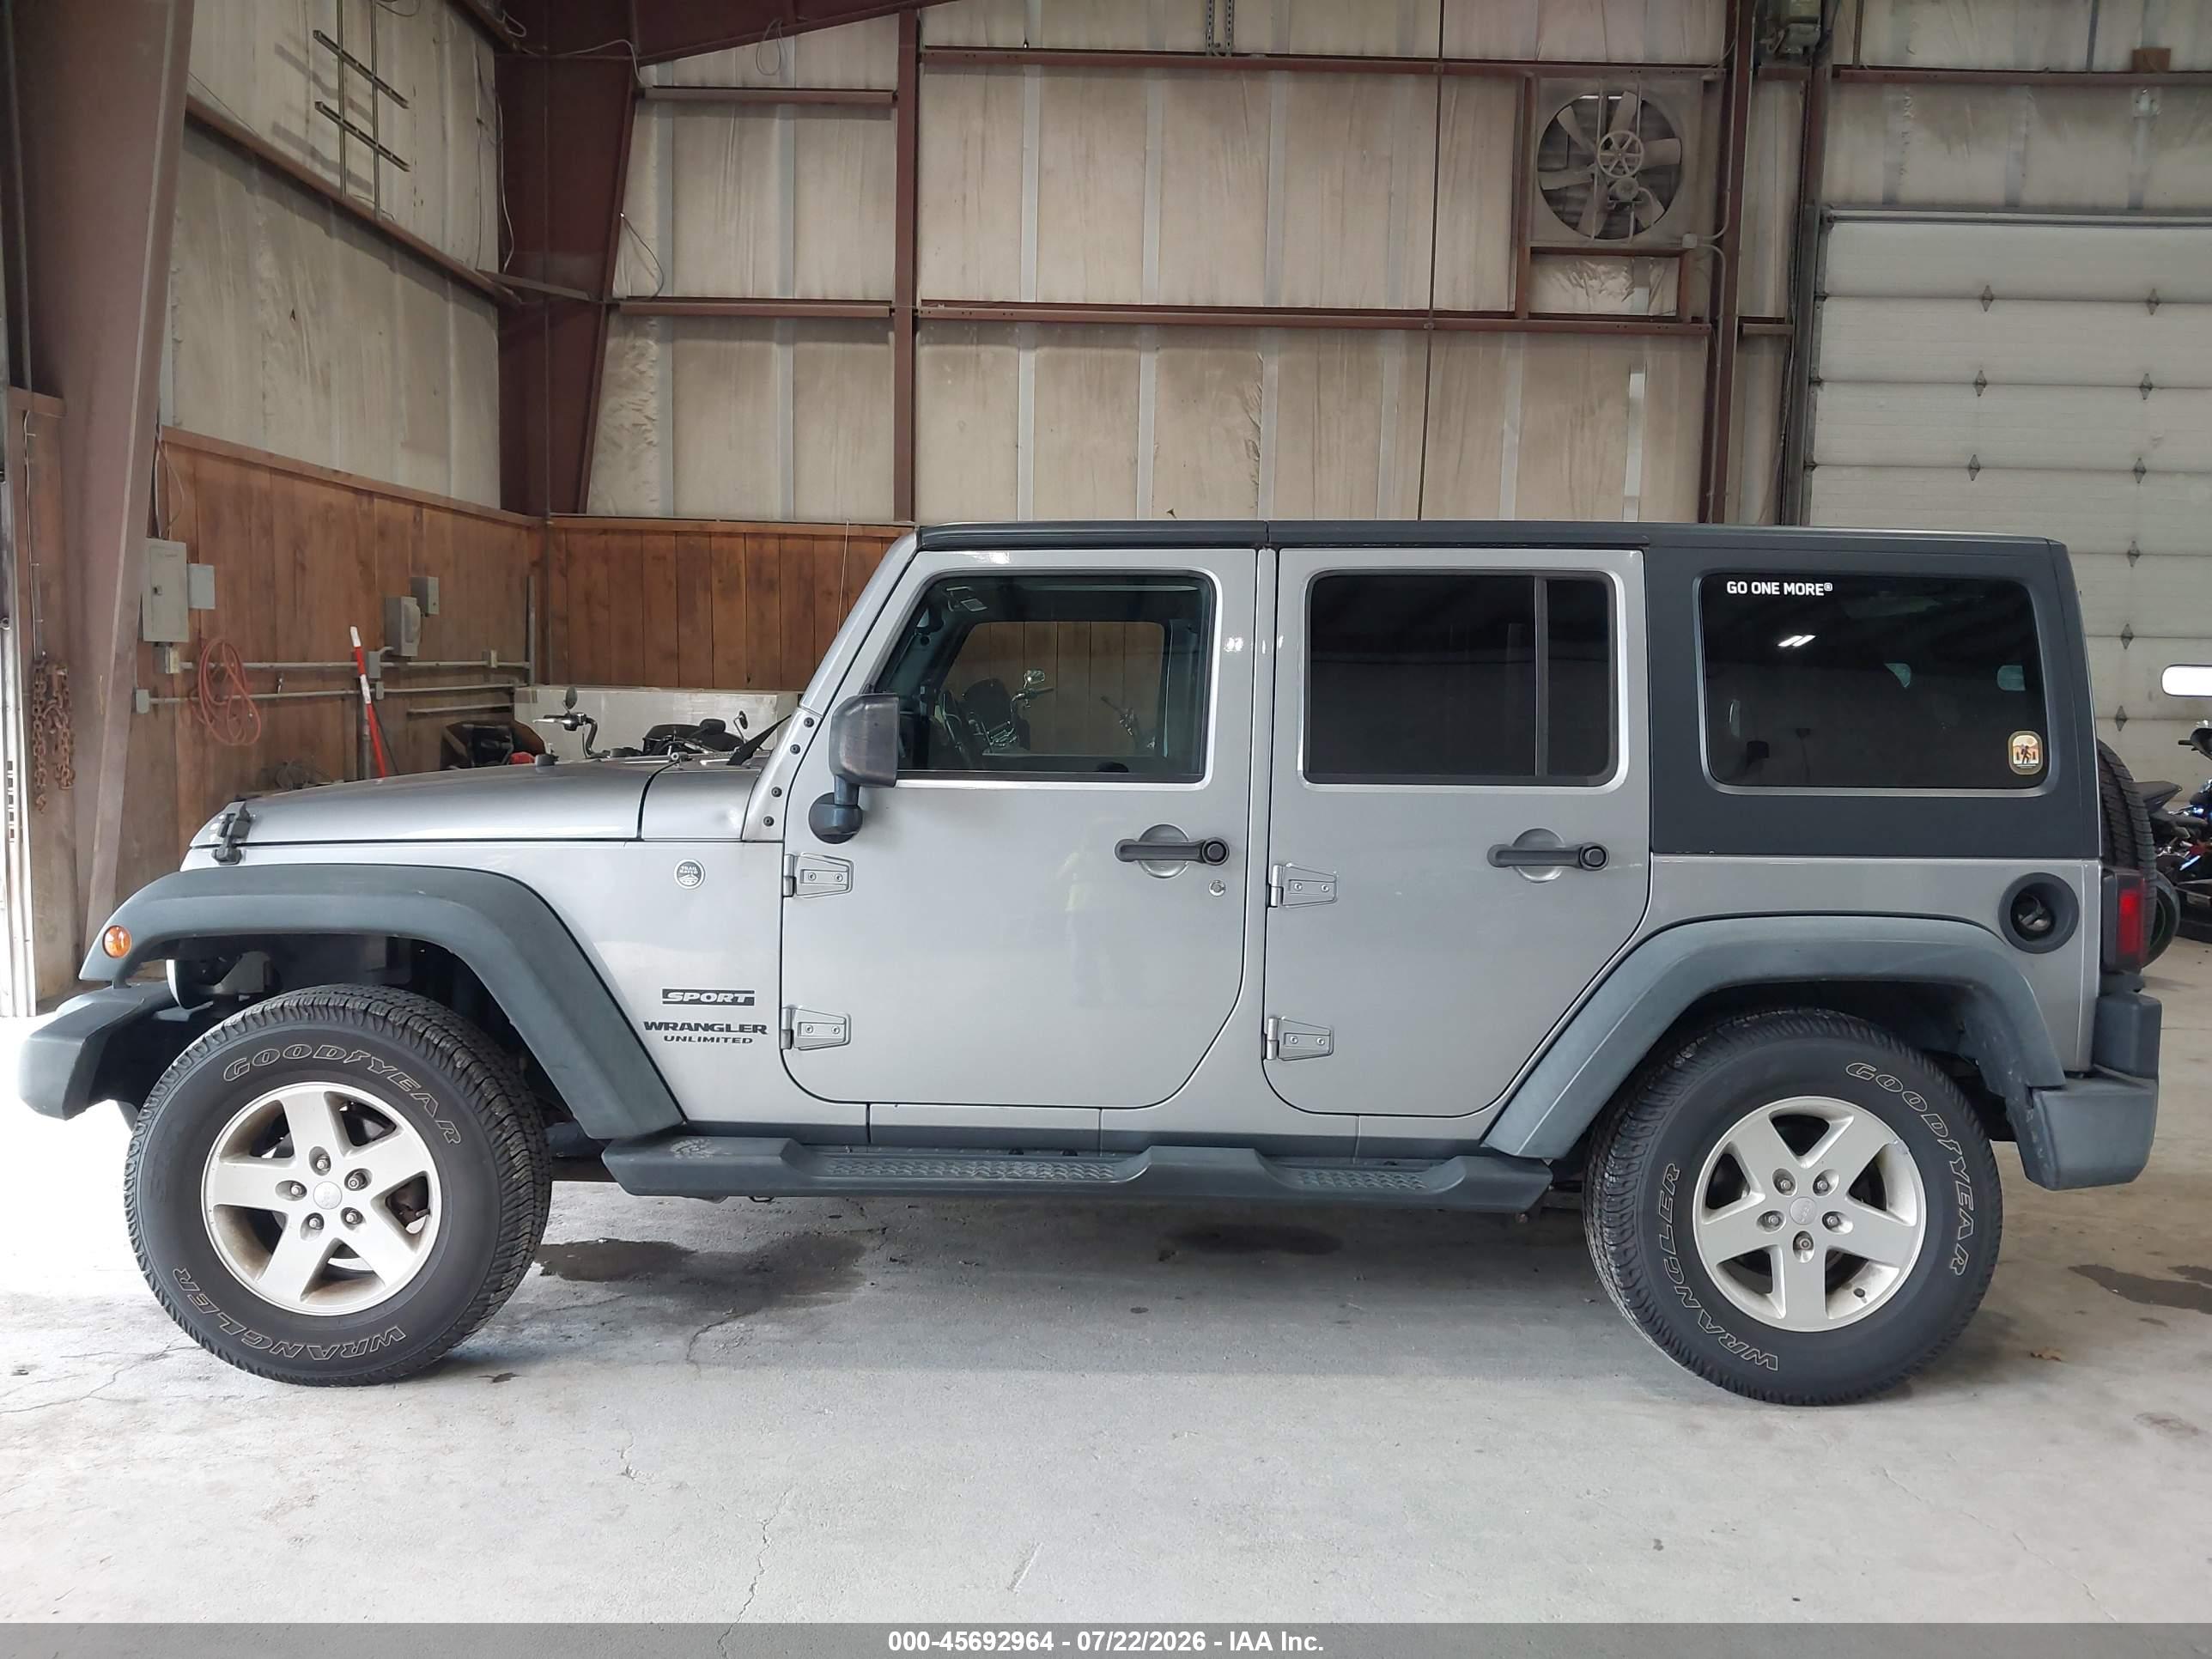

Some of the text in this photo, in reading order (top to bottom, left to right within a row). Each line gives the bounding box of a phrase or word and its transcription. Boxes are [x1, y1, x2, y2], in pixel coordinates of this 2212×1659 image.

[1726, 580, 1748, 594] GO
[1751, 581, 1781, 595] ONE
[665, 991, 753, 1004] SPORT
[644, 1022, 769, 1035] WRANGLER
[664, 1035, 753, 1044] UNLIMITED
[223, 1043, 461, 1145] GOODYEAR
[1845, 1061, 1974, 1277] GOODYEAR
[1656, 1162, 1780, 1371] WRANGLER
[173, 1267, 407, 1361] WRANGLER
